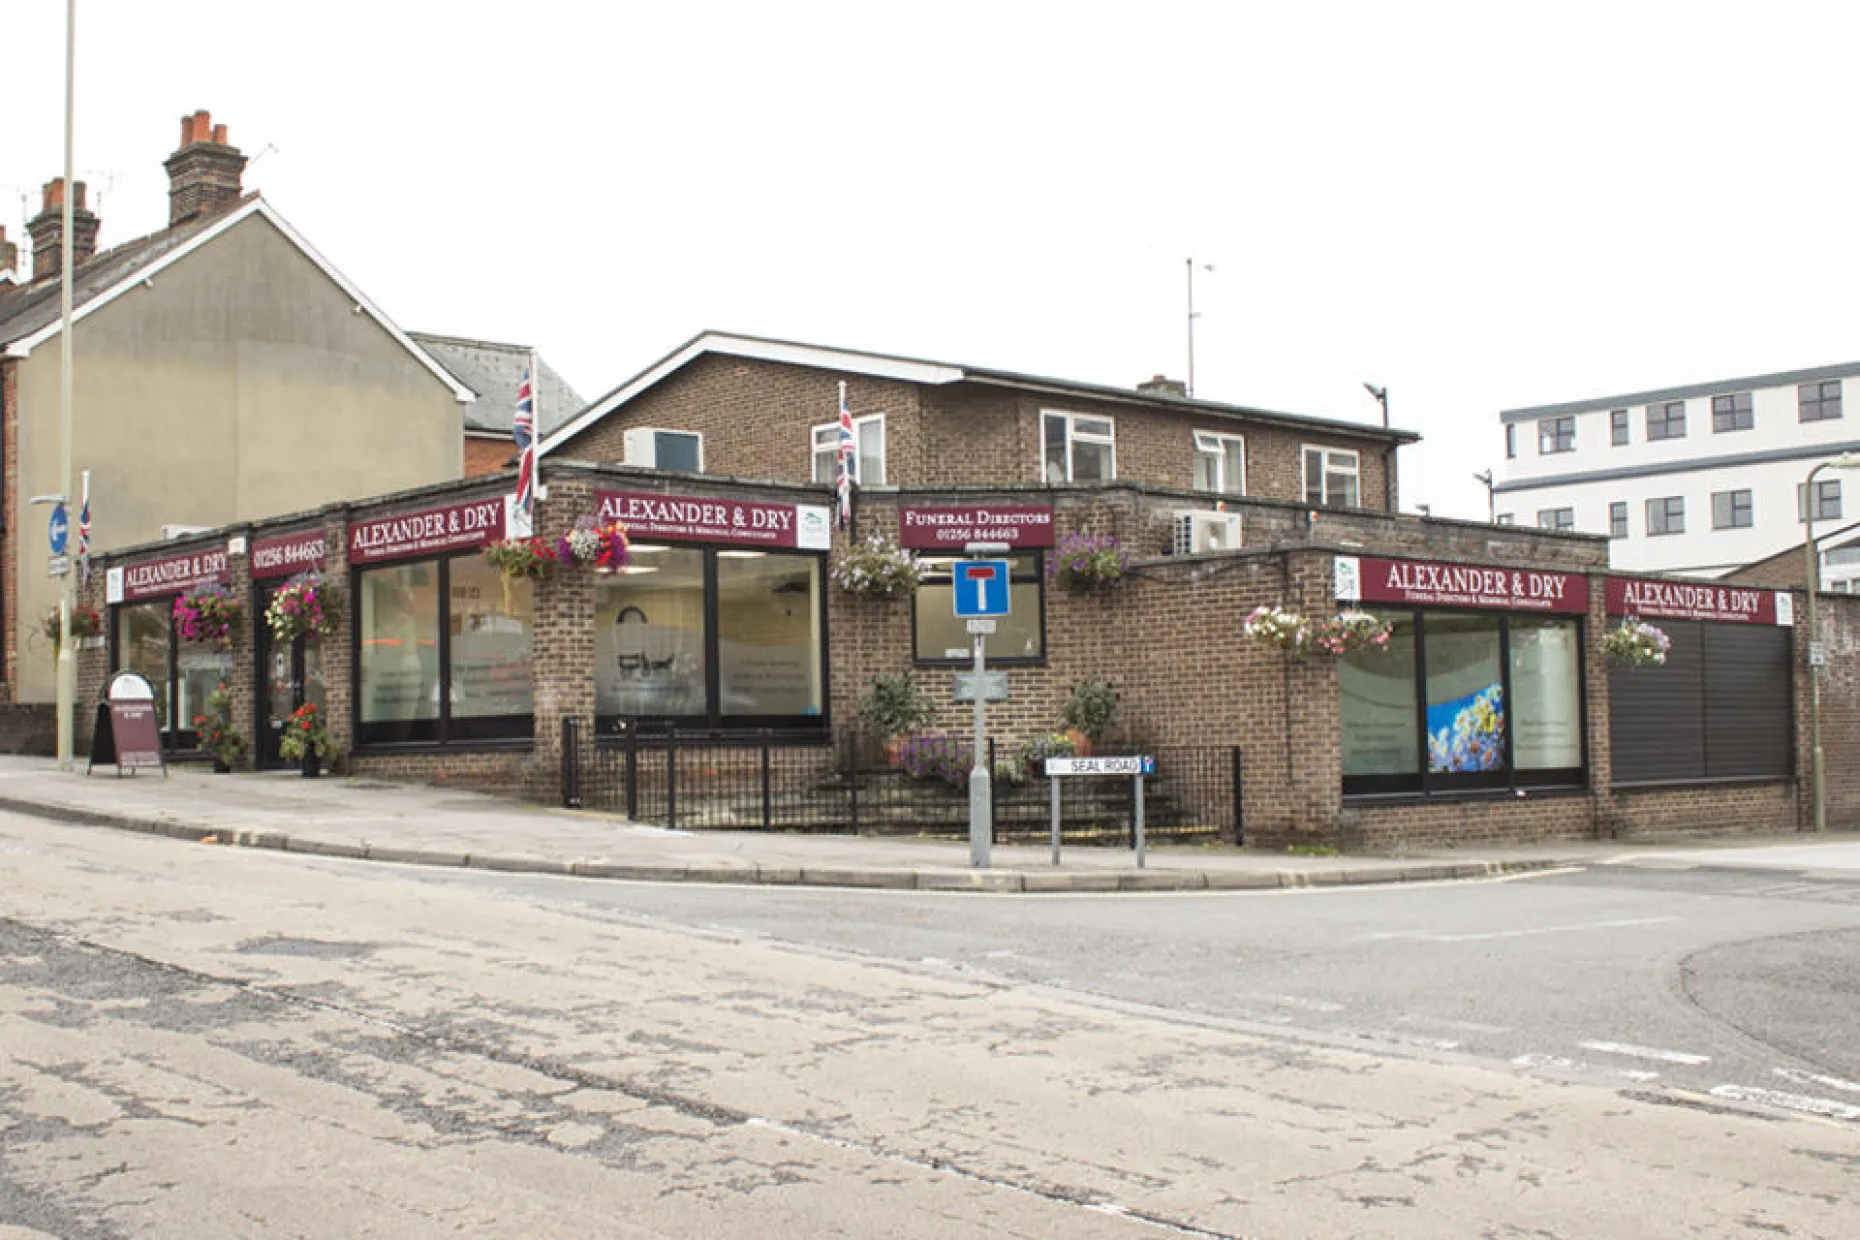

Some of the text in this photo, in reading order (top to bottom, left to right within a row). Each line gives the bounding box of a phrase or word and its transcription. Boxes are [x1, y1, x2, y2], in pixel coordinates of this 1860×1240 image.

[353, 503, 500, 548] ALEXANDER & DRY
[600, 498, 727, 526] ALEXANDER
[731, 506, 746, 528] &
[752, 508, 792, 530] DRY
[905, 509, 1050, 525] FUNERAL DIRECTORS
[1387, 563, 1507, 595] ALEXANDER
[1512, 573, 1525, 597] &
[1529, 574, 1567, 600] DRY
[1624, 581, 1760, 613] ALEXANDER & DRY
[1071, 759, 1138, 771] SEAL ROAD
